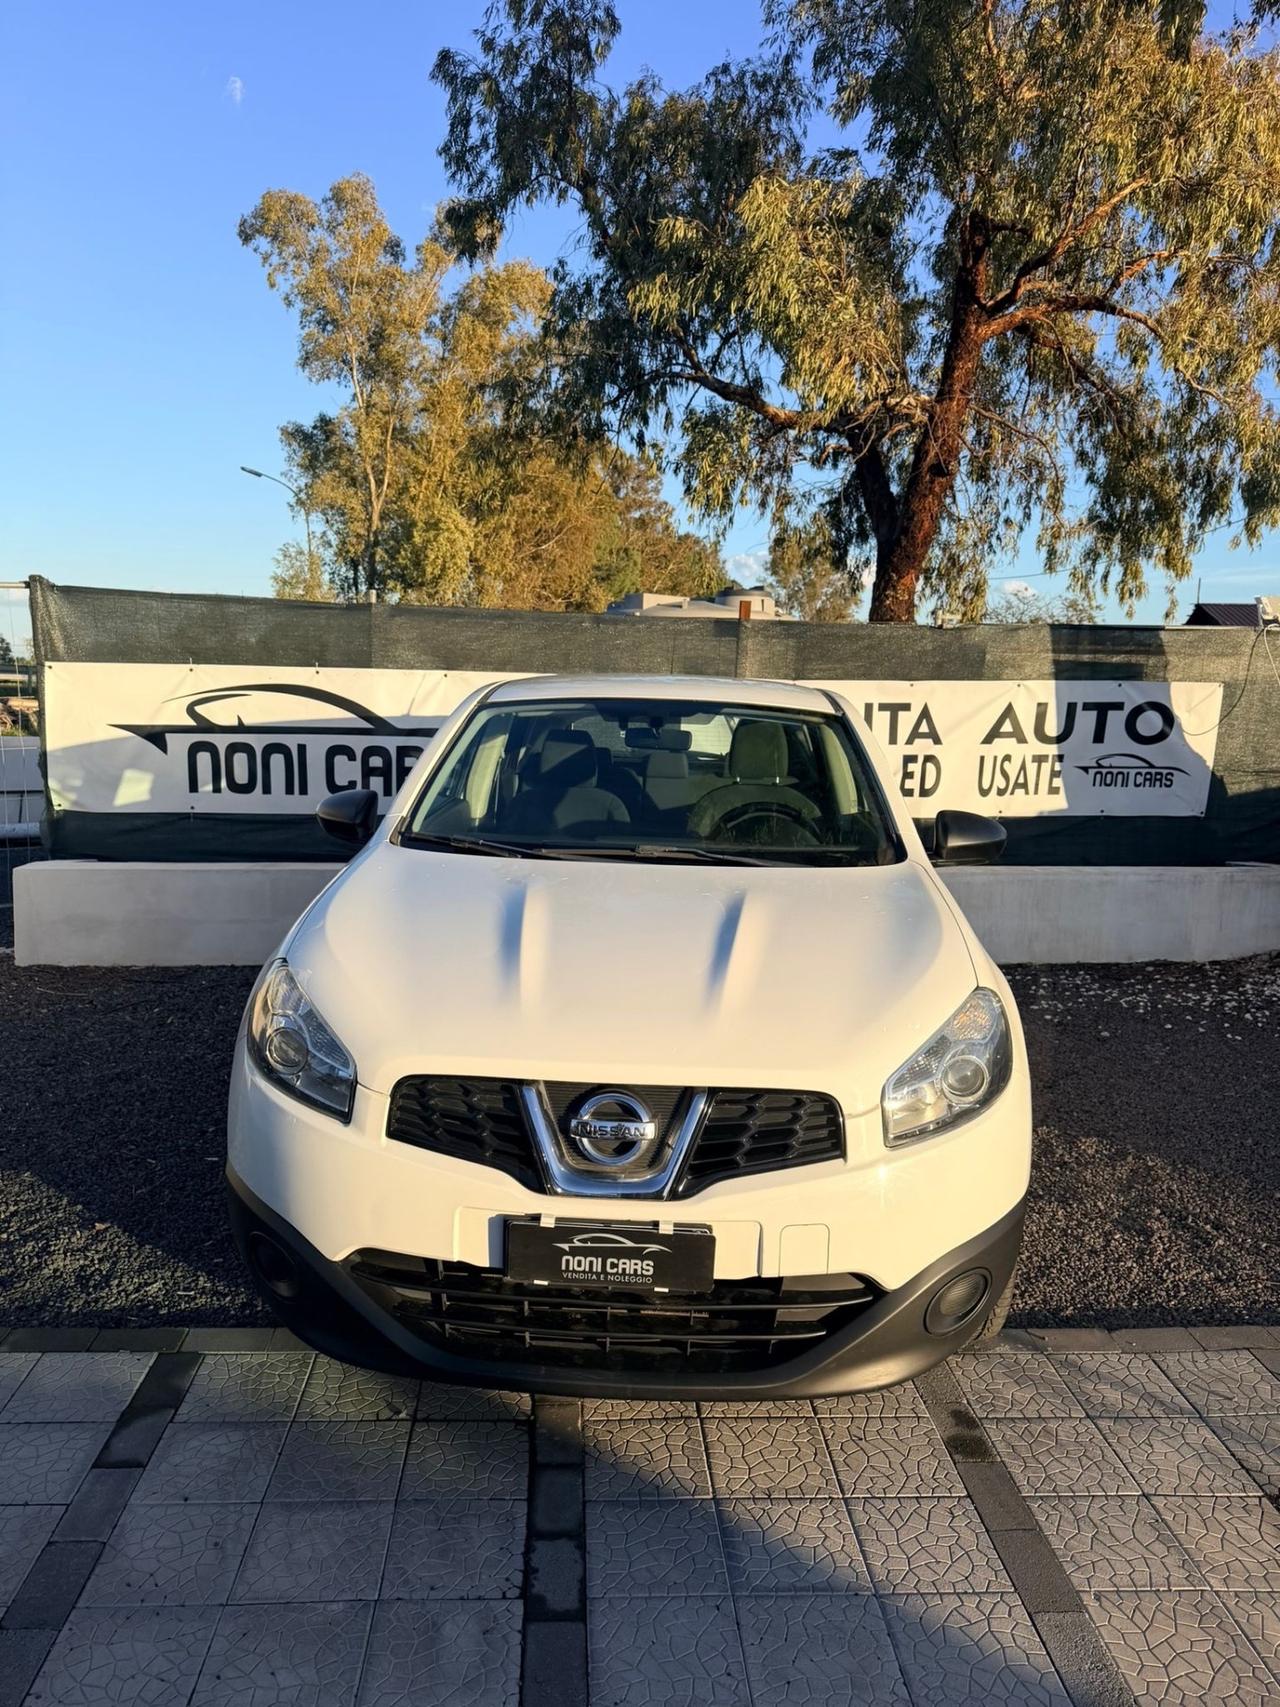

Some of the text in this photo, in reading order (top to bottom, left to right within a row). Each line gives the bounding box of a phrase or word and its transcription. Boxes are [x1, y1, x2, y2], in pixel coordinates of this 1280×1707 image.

[980, 700, 1175, 745] AUTO
[187, 741, 308, 796] NONI
[977, 753, 1065, 798] USATE
[1092, 770, 1175, 788] NONI CARS
[576, 1121, 647, 1138] NISSAN
[561, 1255, 655, 1276] NONI CARS
[562, 1271, 597, 1281] VENDITA
[607, 1274, 653, 1284] NOLEGGIO
